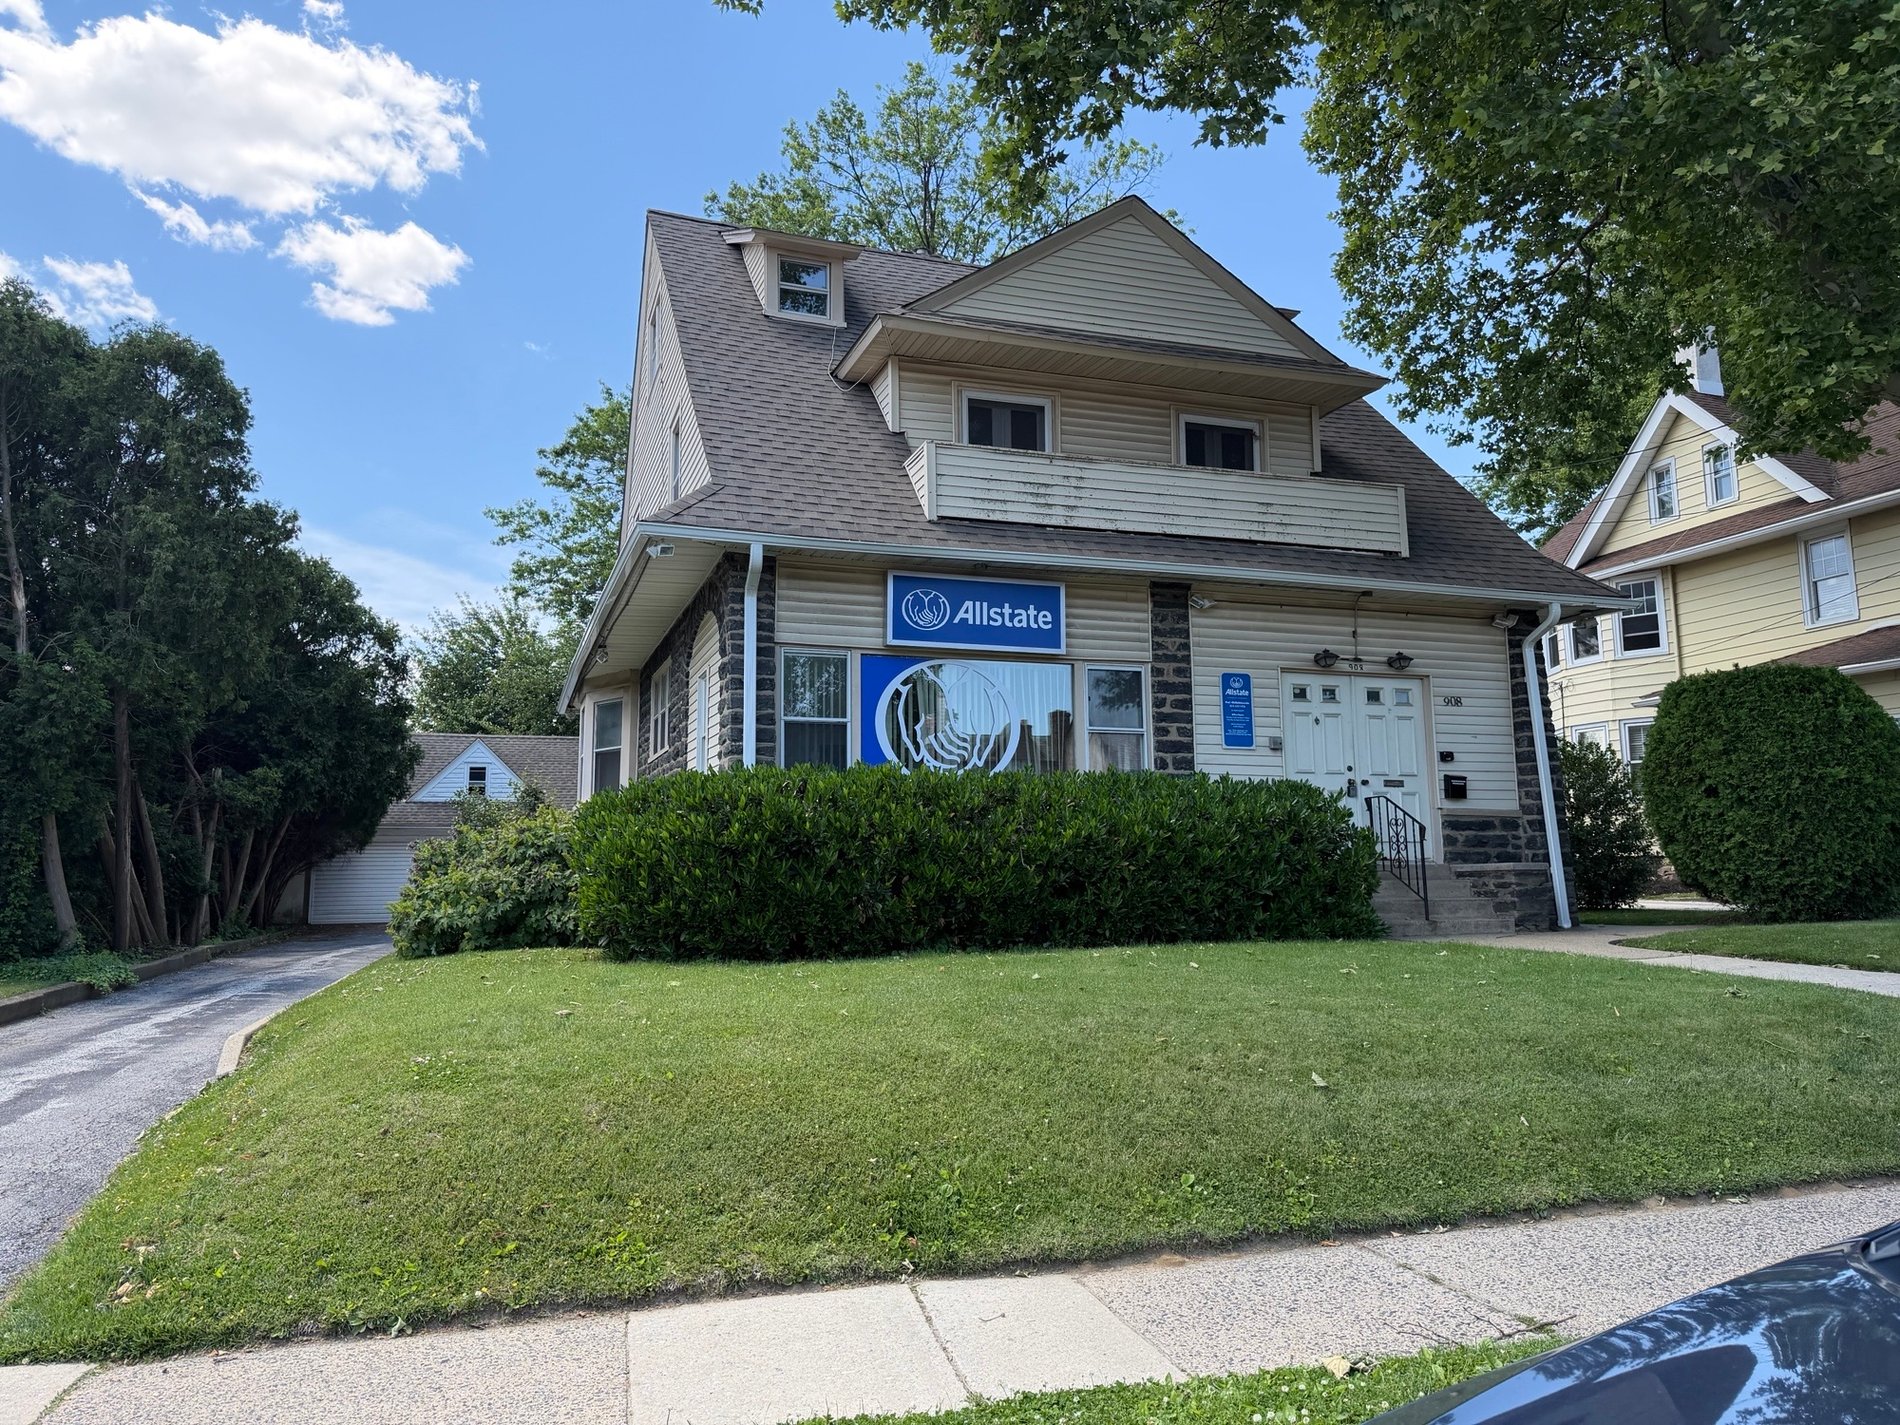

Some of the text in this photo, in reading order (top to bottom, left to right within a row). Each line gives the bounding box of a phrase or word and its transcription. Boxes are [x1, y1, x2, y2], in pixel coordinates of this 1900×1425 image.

[953, 600, 1053, 630] Allstate
[1224, 688, 1250, 696] Allstate
[1443, 696, 1463, 707] 908
